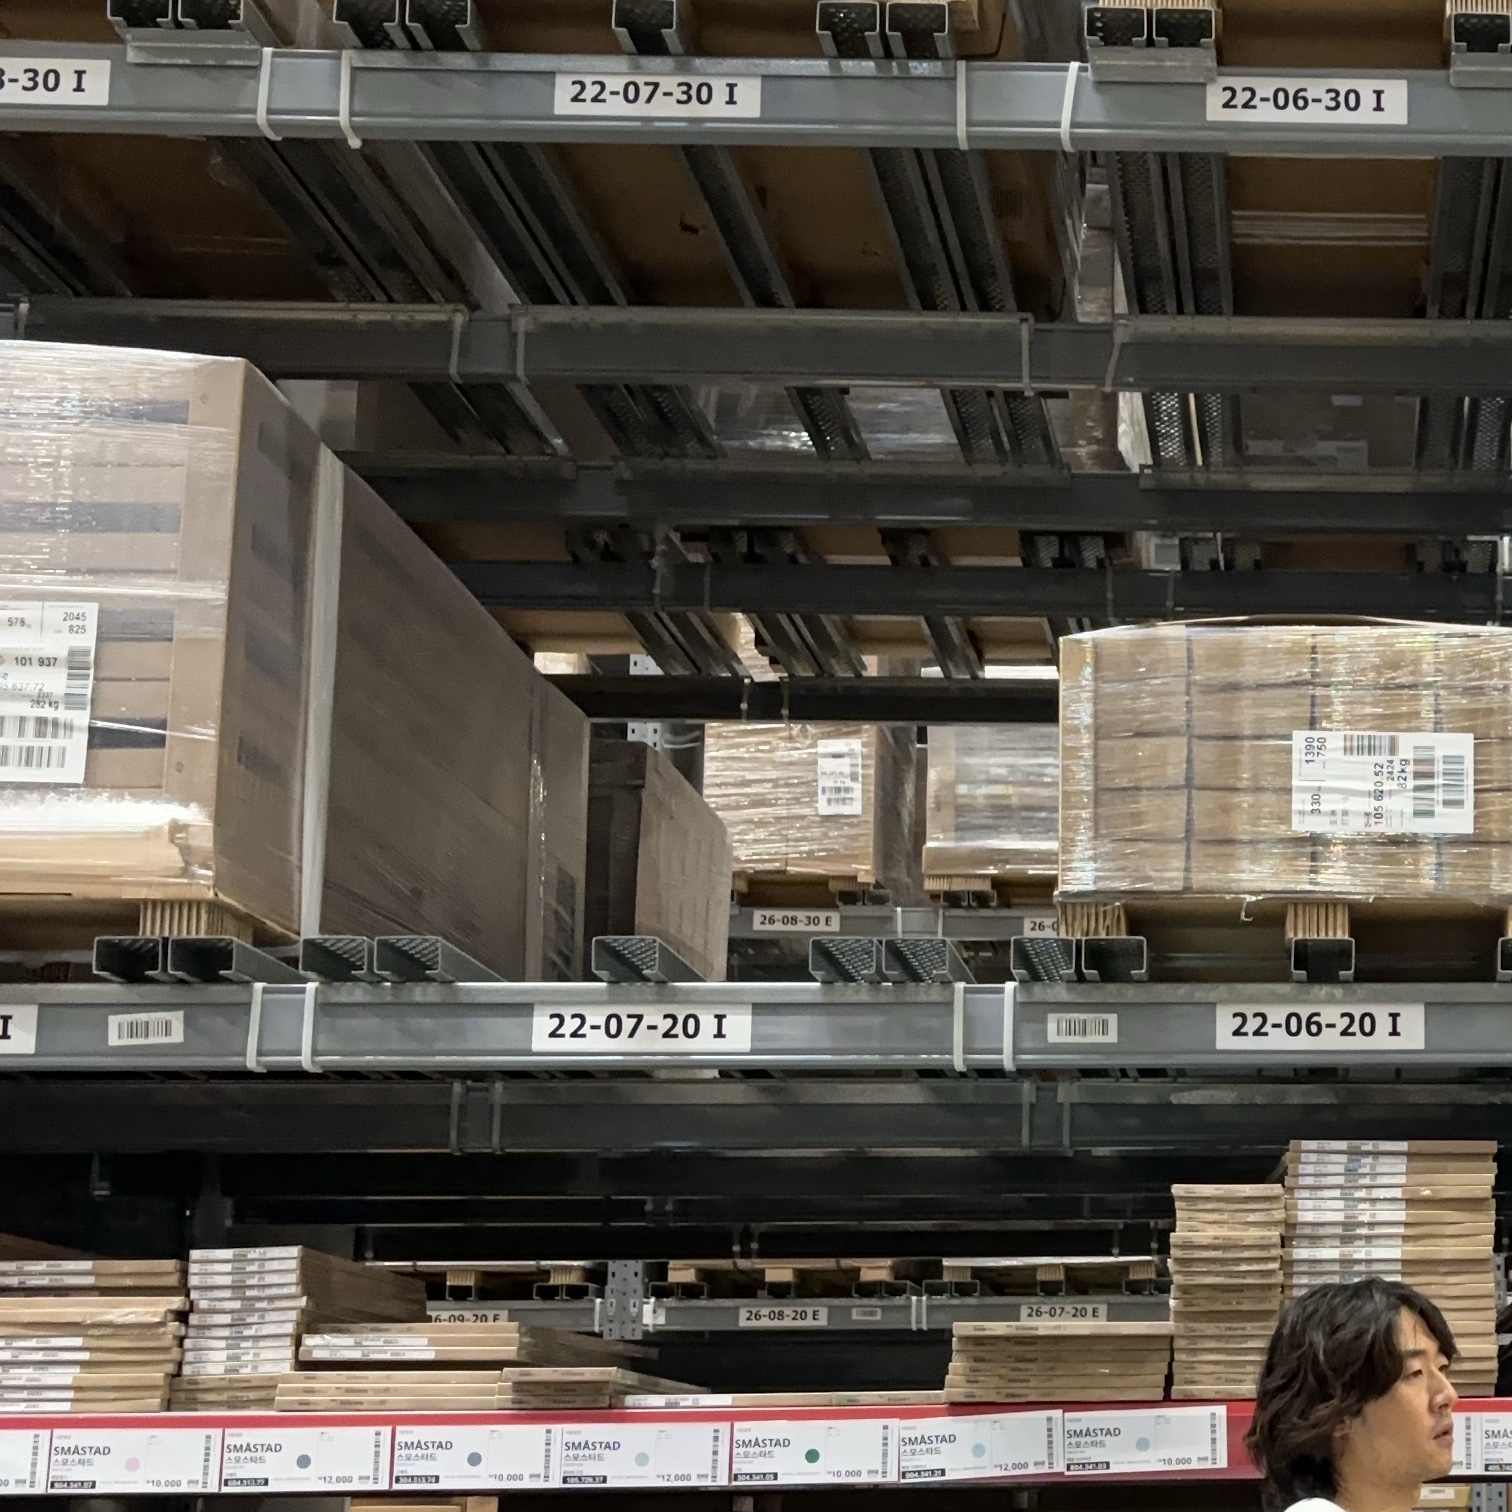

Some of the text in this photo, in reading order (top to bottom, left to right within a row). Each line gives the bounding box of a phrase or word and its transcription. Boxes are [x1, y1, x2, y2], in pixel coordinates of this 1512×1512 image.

[73, 70, 87, 92] I
[569, 79, 739, 105] 22-07-30 I
[1221, 86, 1385, 112] 22-06-30 I
[63, 611, 87, 622] 2045
[68, 624, 87, 634] 825
[14, 656, 58, 667] 101 937
[1305, 736, 1316, 764] 1390
[1316, 737, 1327, 758] 750
[1386, 759, 1395, 782] 2424
[1311, 793, 1321, 814] 330
[760, 914, 832, 927] 26-08-30 E
[547, 1014, 727, 1040] 22-07-20 I
[1231, 1012, 1402, 1037] 22-06-20 I
[745, 1310, 820, 1321] 26-08-20 E
[1027, 1307, 1100, 1318] 26-07-20 E
[1066, 1427, 1121, 1439] SMÅSTAD
[397, 1440, 453, 1451] SMÅSTAD
[564, 1440, 621, 1451] SMÅSTAD
[735, 1437, 791, 1448] SMÅSTAD
[900, 1433, 957, 1446] SMÅSTAD
[53, 1444, 111, 1456] SMÅSTAD
[226, 1442, 282, 1453] SMÅSTAD
